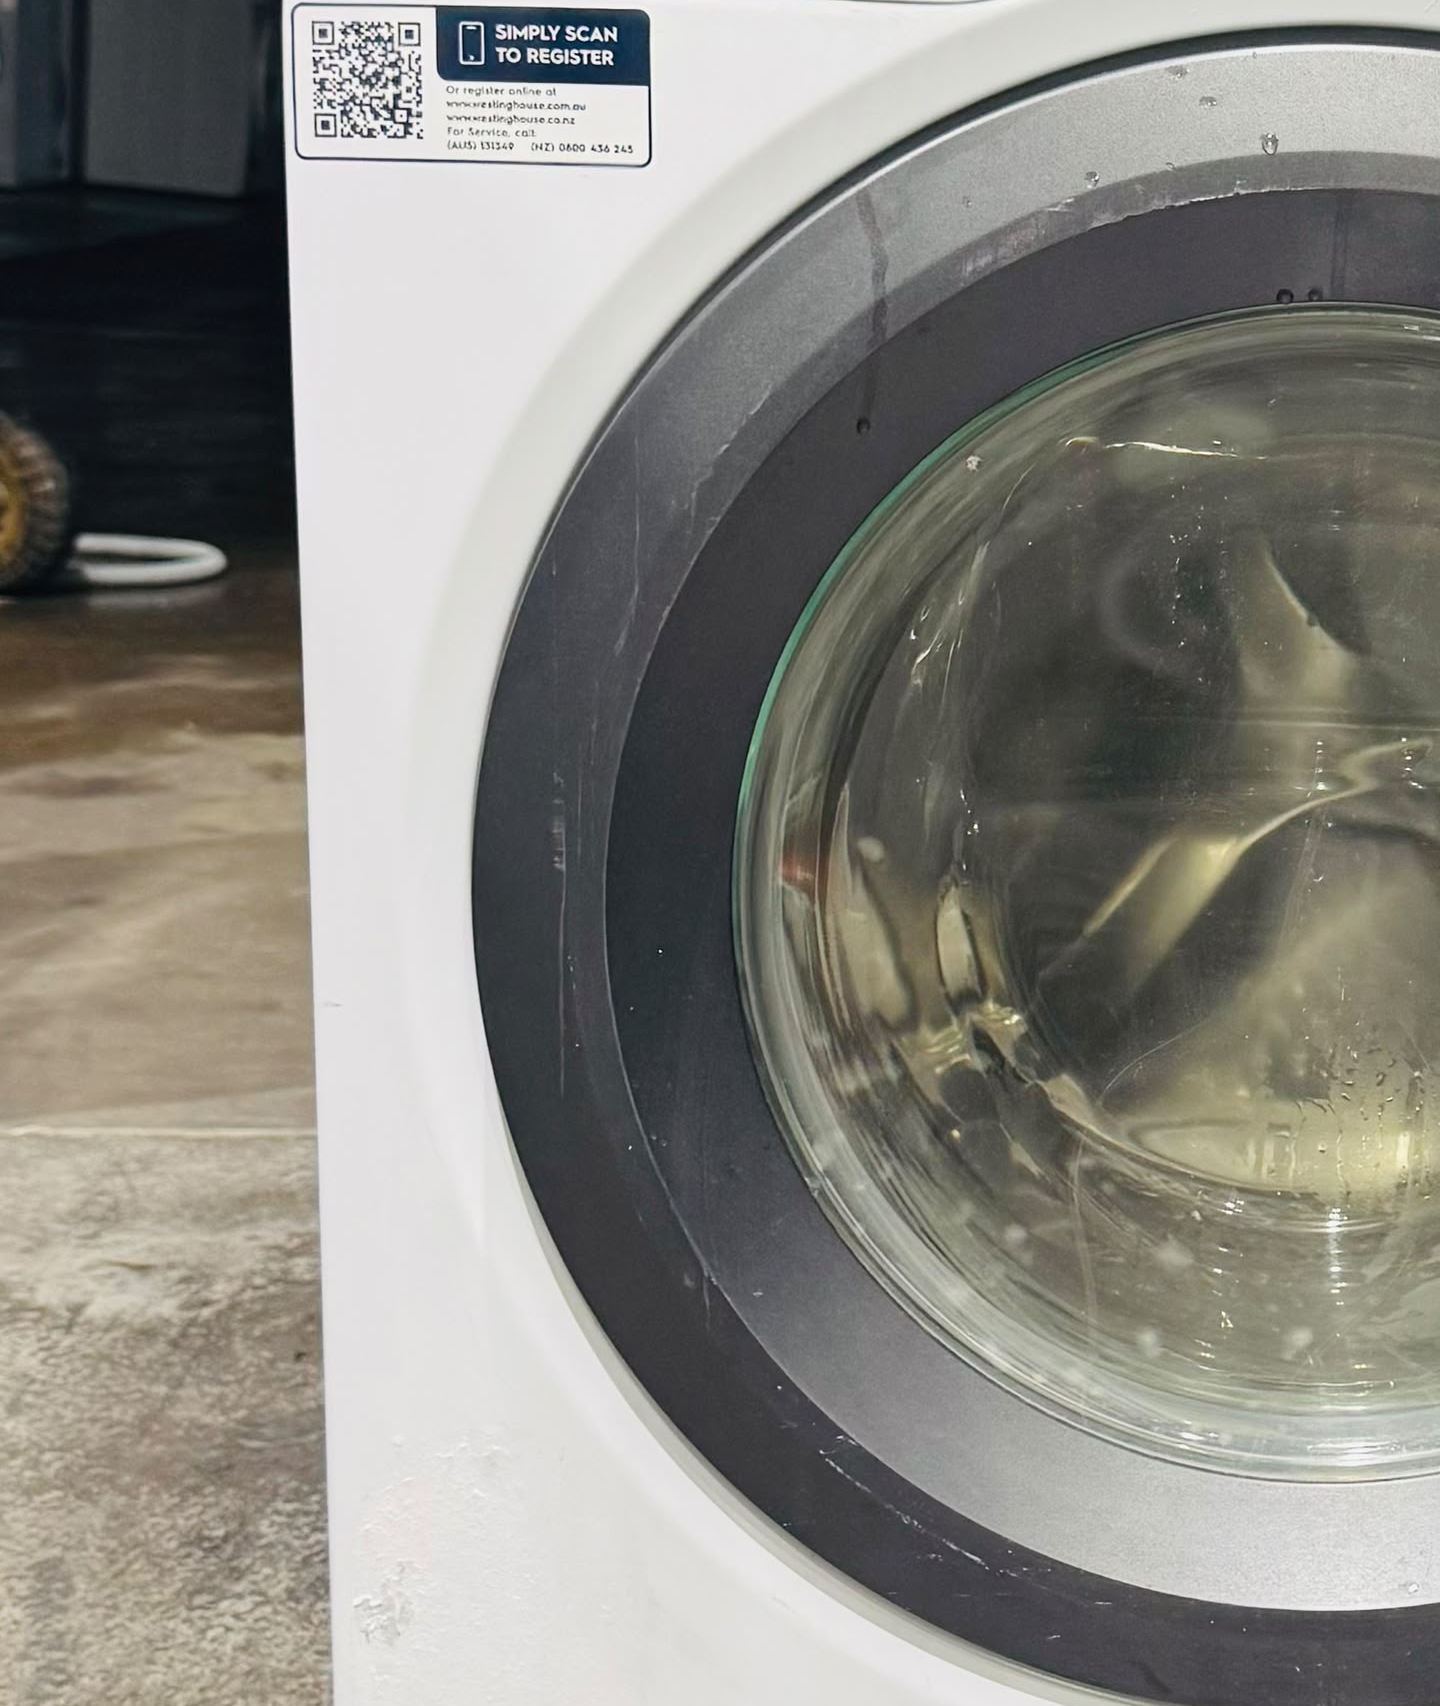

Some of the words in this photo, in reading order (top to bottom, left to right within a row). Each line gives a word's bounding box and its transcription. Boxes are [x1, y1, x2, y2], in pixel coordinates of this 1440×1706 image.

[495, 24, 561, 41] SIMPLY
[564, 25, 619, 43] SCAN
[495, 46, 522, 64] TO
[526, 47, 615, 66] REGISTER
[446, 85, 459, 95] Or
[463, 86, 505, 97] register
[508, 86, 542, 97] online
[545, 87, 556, 96] at
[447, 126, 464, 136] For
[447, 140, 477, 151] (AUS)
[531, 142, 555, 152] (NZ)
[559, 142, 586, 153] 0800
